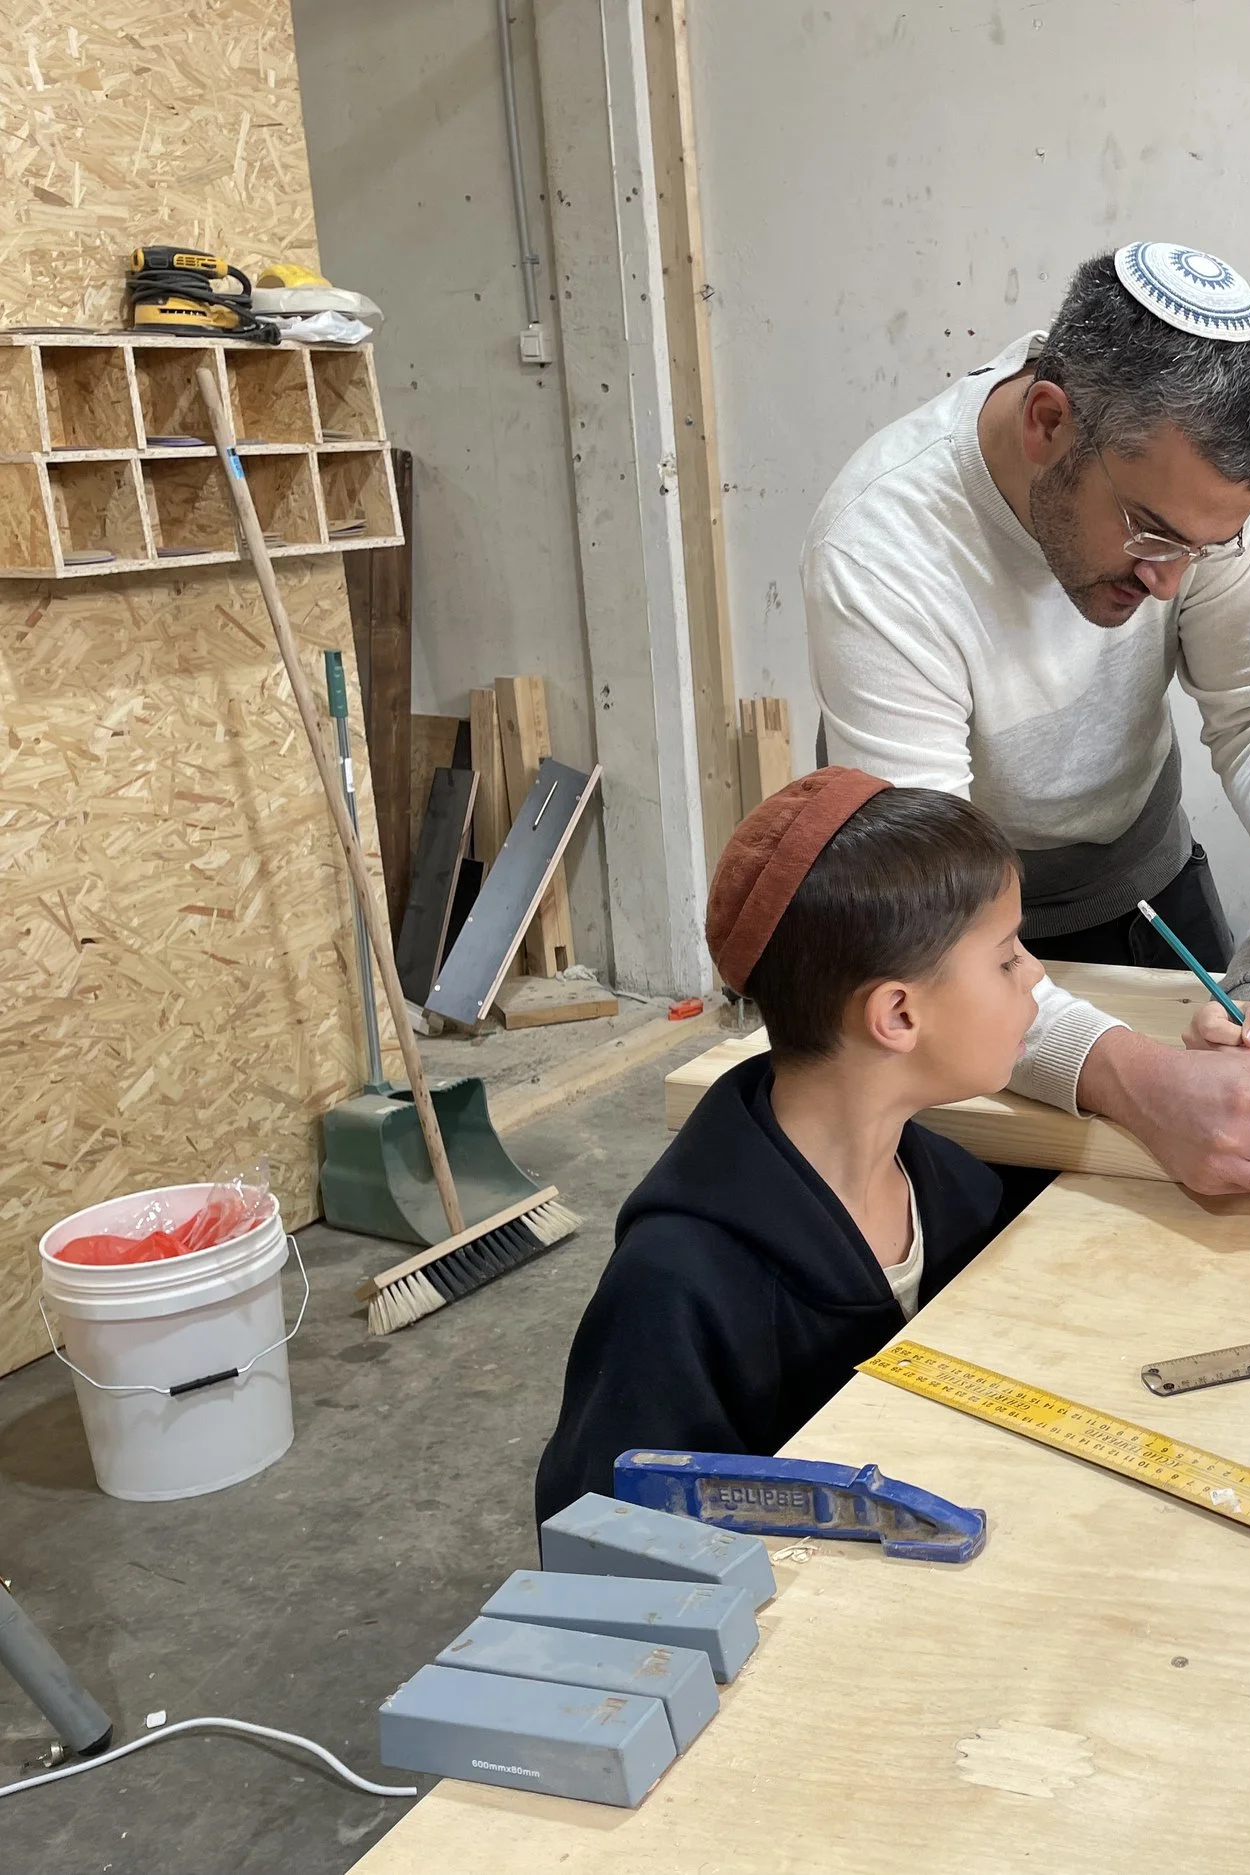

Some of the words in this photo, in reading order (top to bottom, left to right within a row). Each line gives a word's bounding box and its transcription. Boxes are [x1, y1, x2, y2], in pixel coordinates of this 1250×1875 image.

[955, 1390, 967, 1398] 23
[981, 1400, 993, 1408] 21
[1029, 1397, 1041, 1405] 15
[1099, 1423, 1111, 1431] 10
[1064, 1432, 1076, 1440] 15
[1083, 1429, 1142, 1454] TEMPERATO
[1093, 1443, 1105, 1451] 13
[1108, 1449, 1120, 1457] 12
[719, 1487, 805, 1507] ECLIPSE
[471, 1757, 541, 1778] 600mmx80mm
